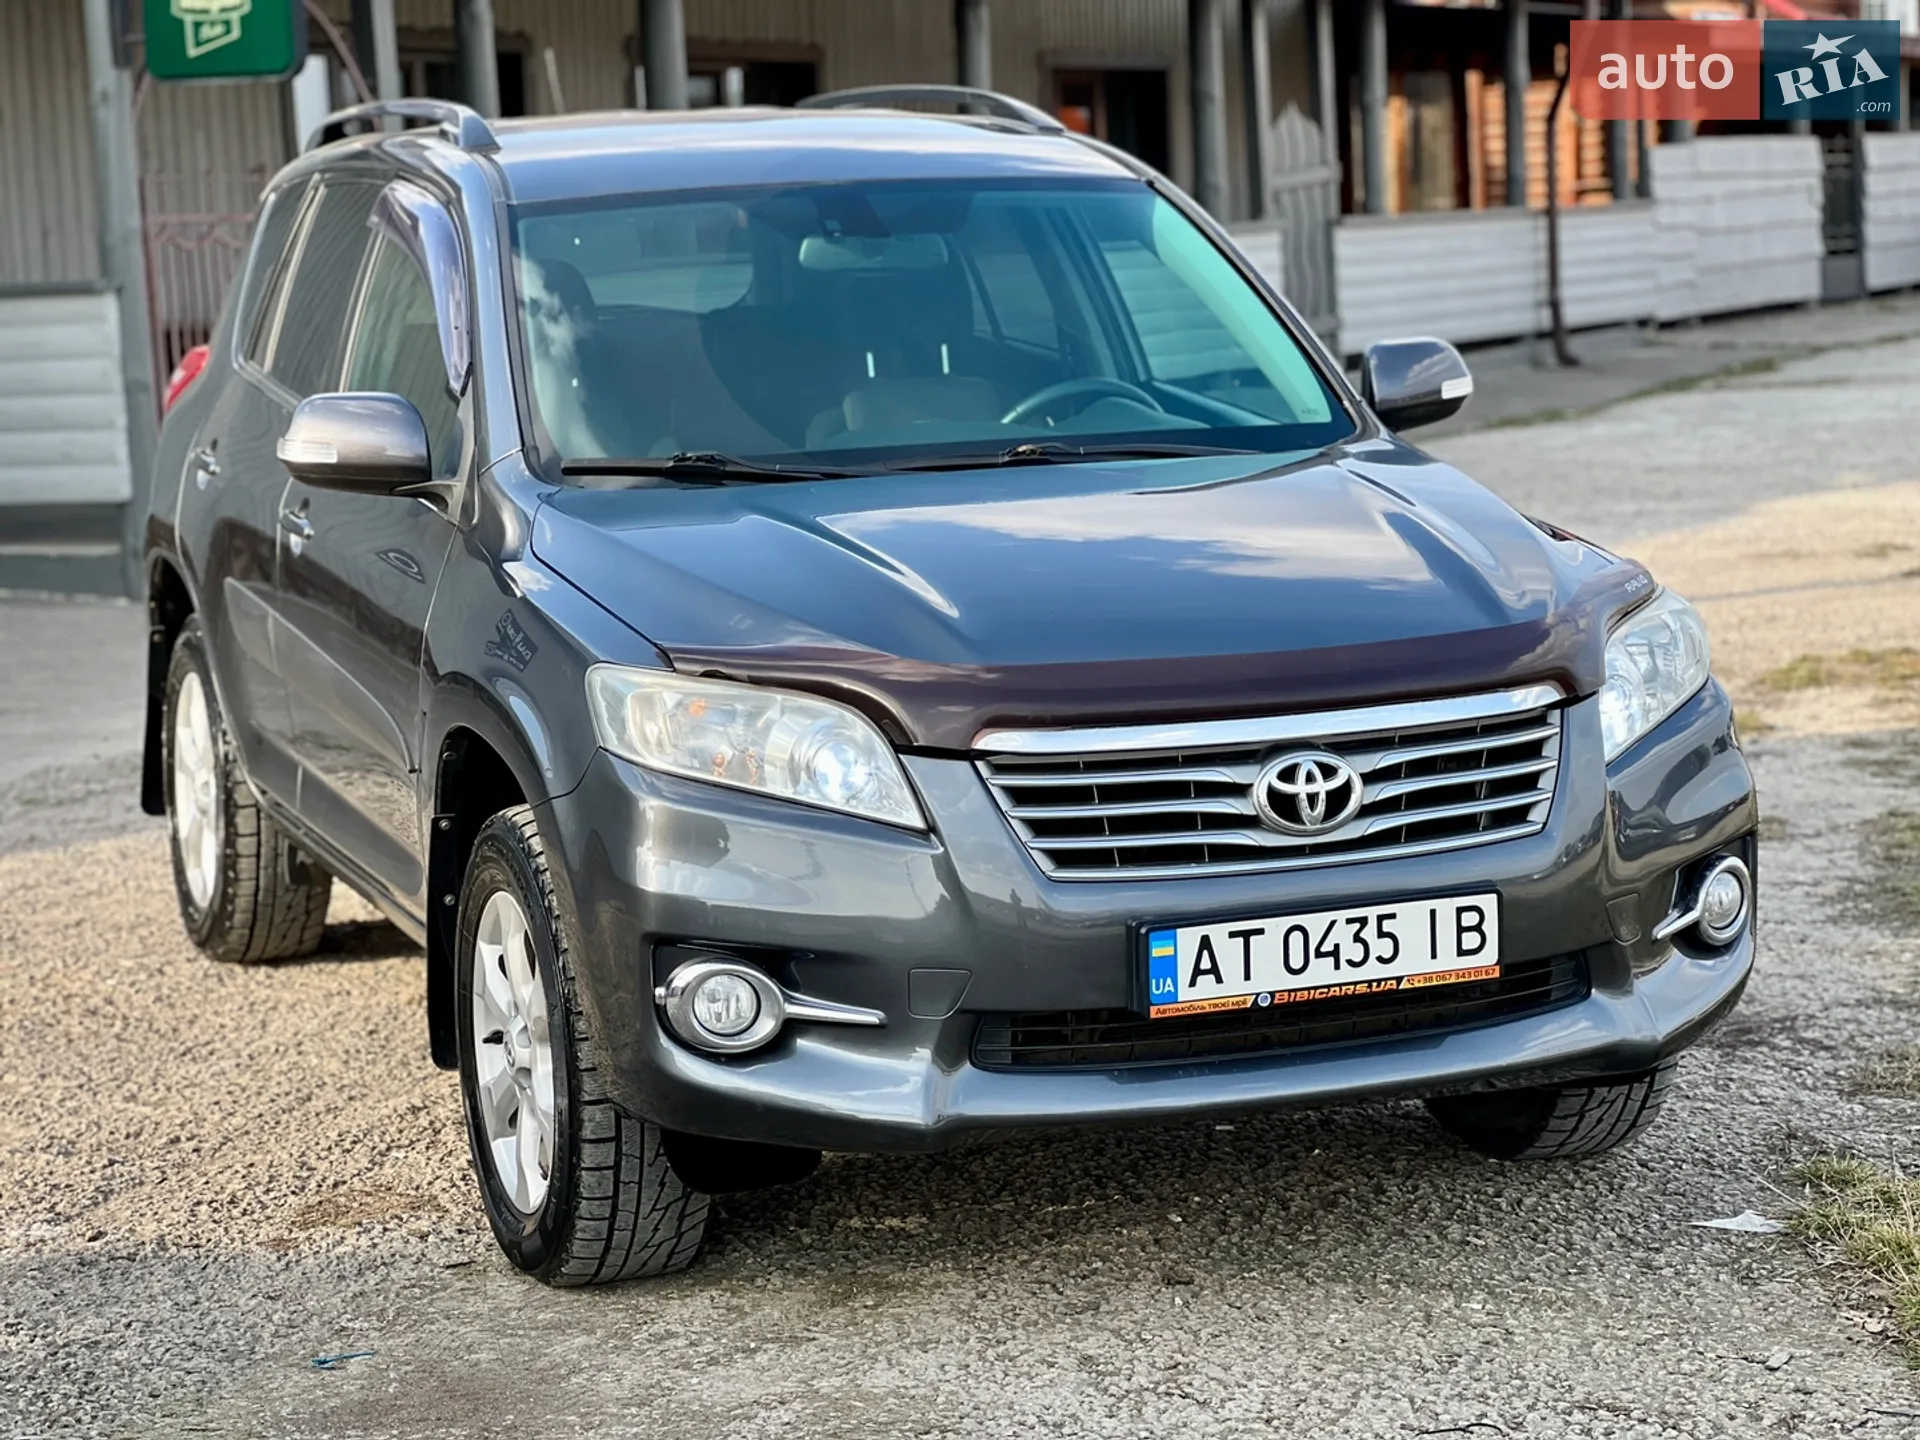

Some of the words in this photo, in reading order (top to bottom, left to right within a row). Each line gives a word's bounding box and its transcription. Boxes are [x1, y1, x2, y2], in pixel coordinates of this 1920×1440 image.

[1188, 927, 1265, 988] AT
[1282, 912, 1400, 976] 0435
[1429, 904, 1487, 960] IB
[1152, 977, 1175, 995] UA
[1417, 976, 1434, 985] +38
[1435, 973, 1453, 983] 067
[1454, 970, 1472, 980] 343
[1273, 979, 1398, 1004] BIBICARS.UA
[1155, 1000, 1207, 1016] Автомобіль
